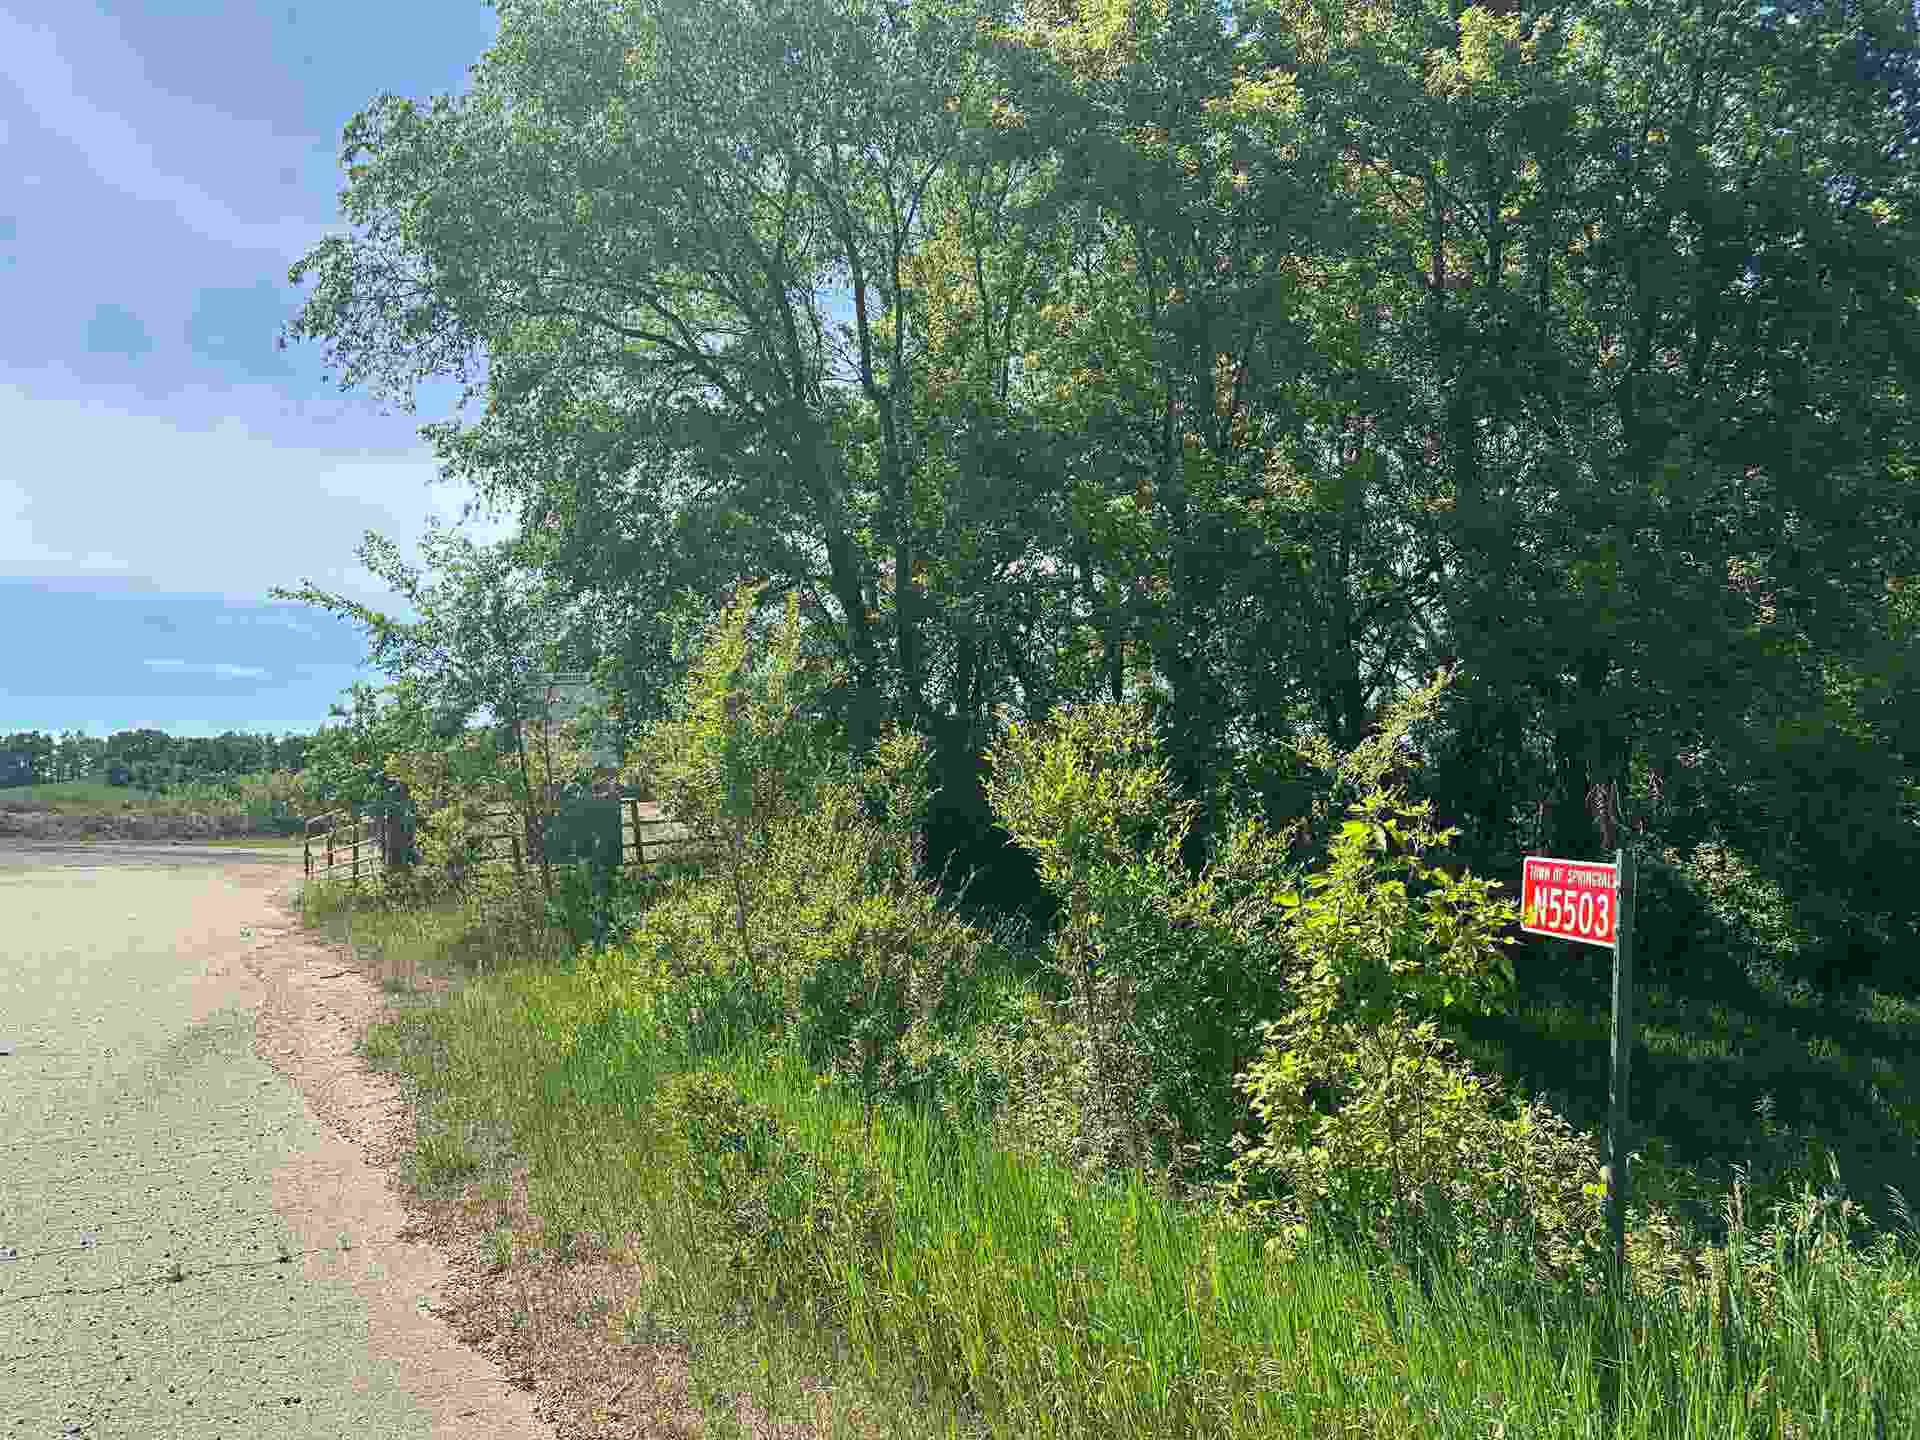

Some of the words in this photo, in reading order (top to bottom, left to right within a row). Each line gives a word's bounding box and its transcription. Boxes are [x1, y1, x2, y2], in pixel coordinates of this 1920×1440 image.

[1530, 864, 1551, 881] TOWN
[1553, 866, 1565, 881] OF
[1535, 885, 1609, 938] N5503
